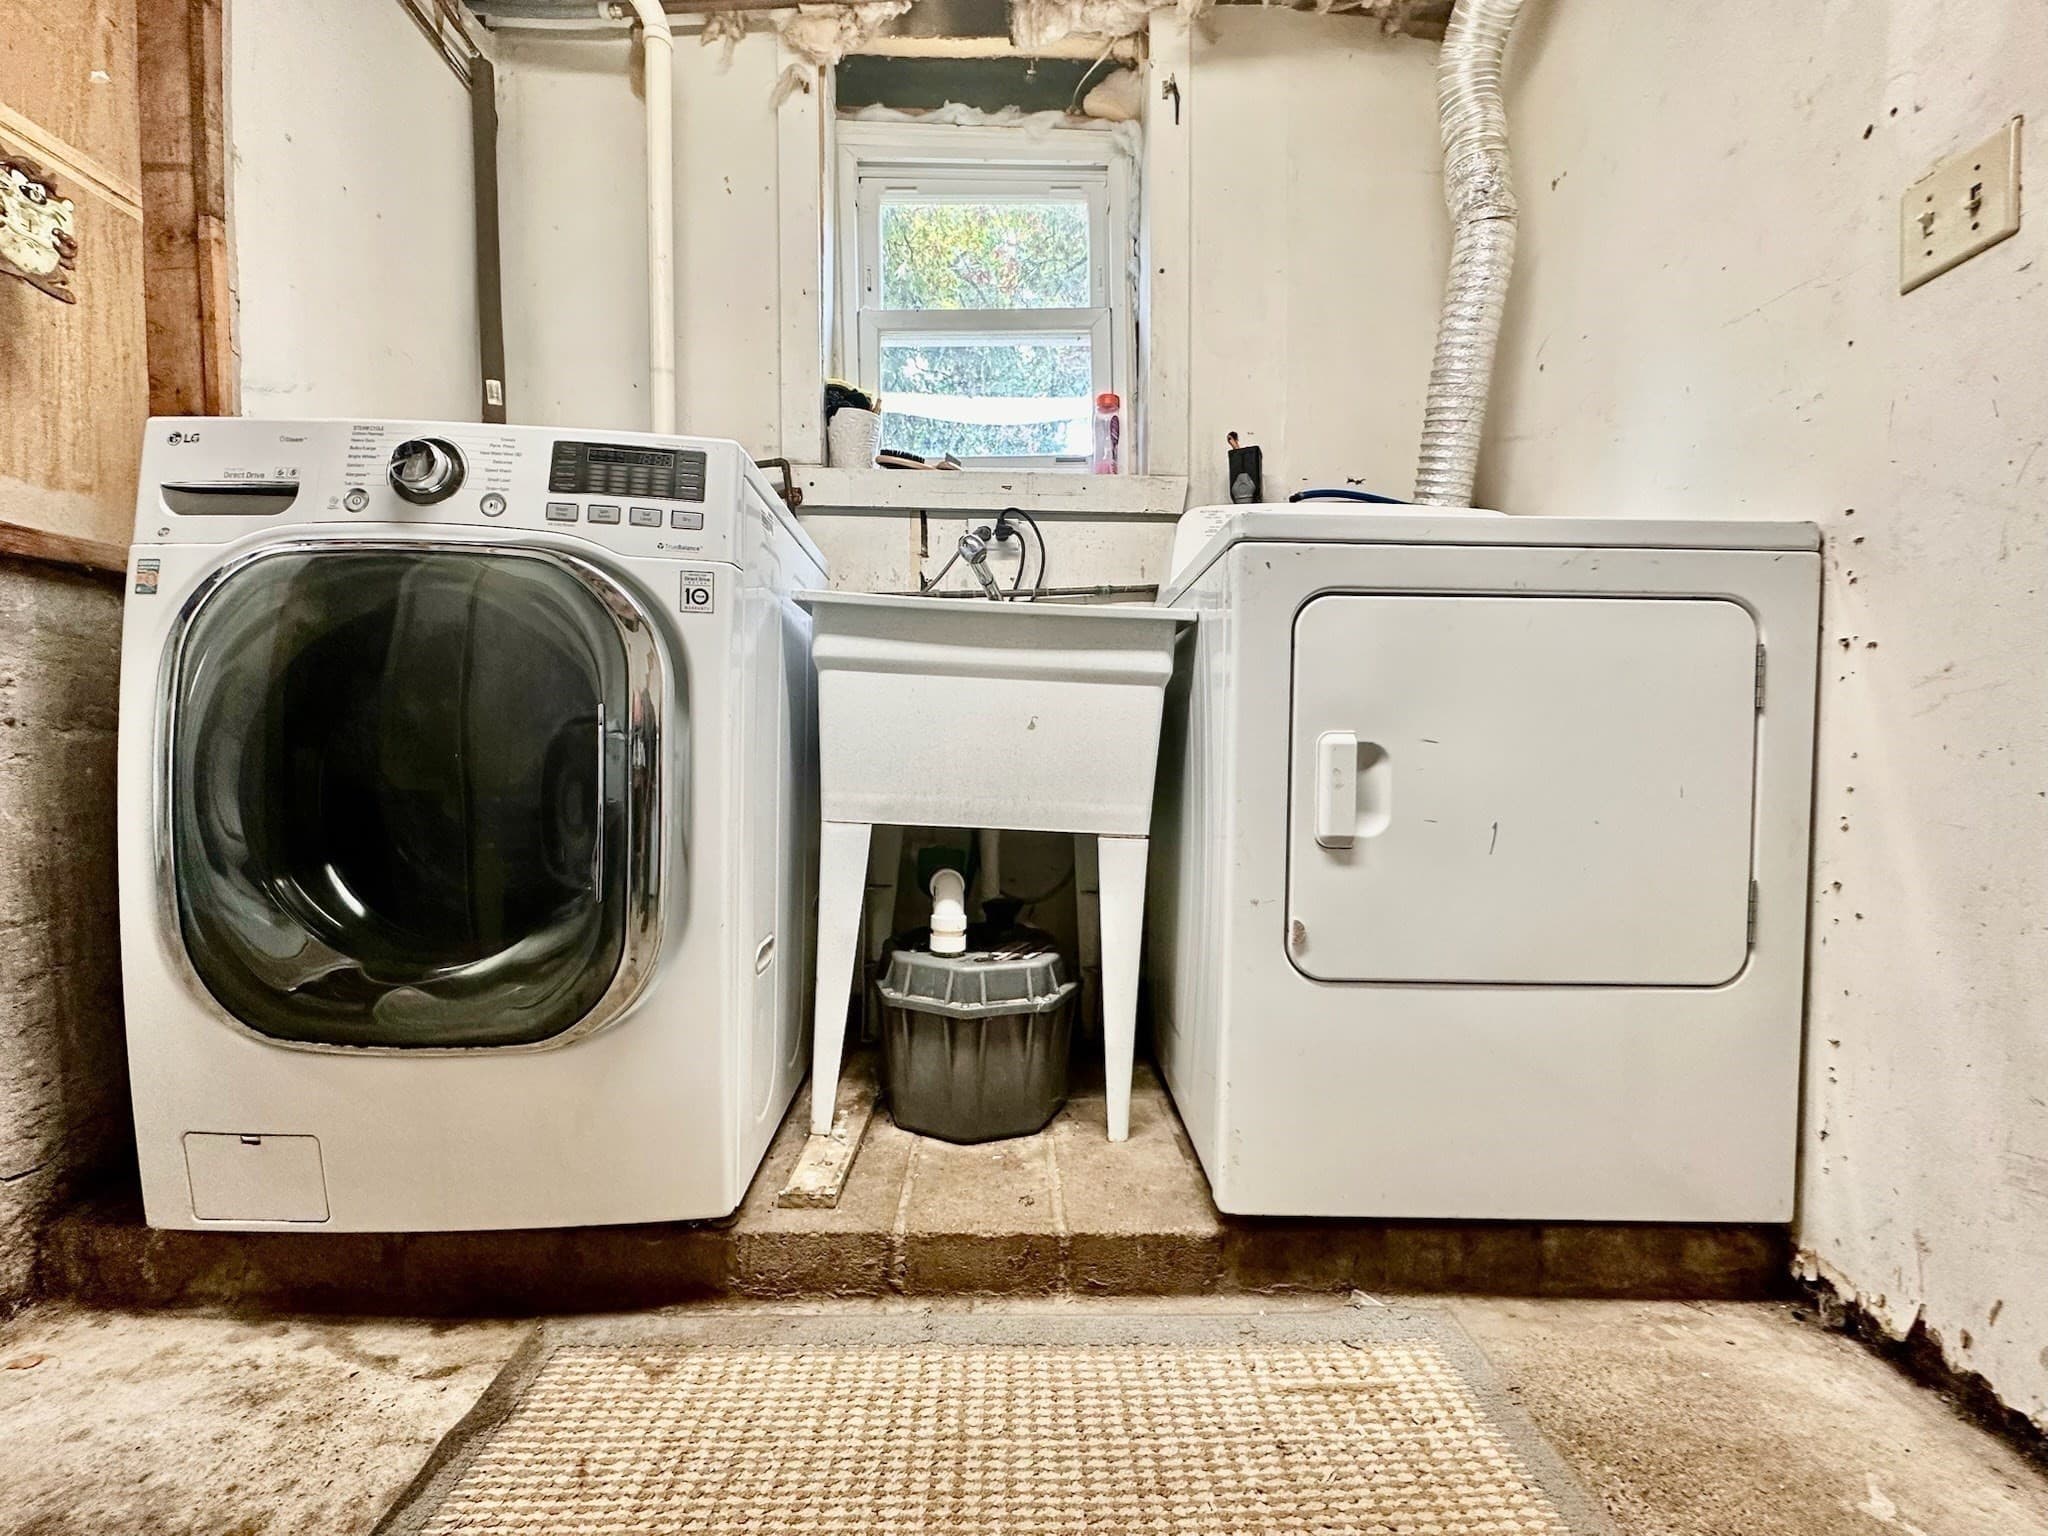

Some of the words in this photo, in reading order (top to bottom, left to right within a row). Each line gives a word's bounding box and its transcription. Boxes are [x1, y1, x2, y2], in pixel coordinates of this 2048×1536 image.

[183, 433, 200, 443] LG
[246, 471, 265, 479] Drive
[685, 588, 710, 605] 10
